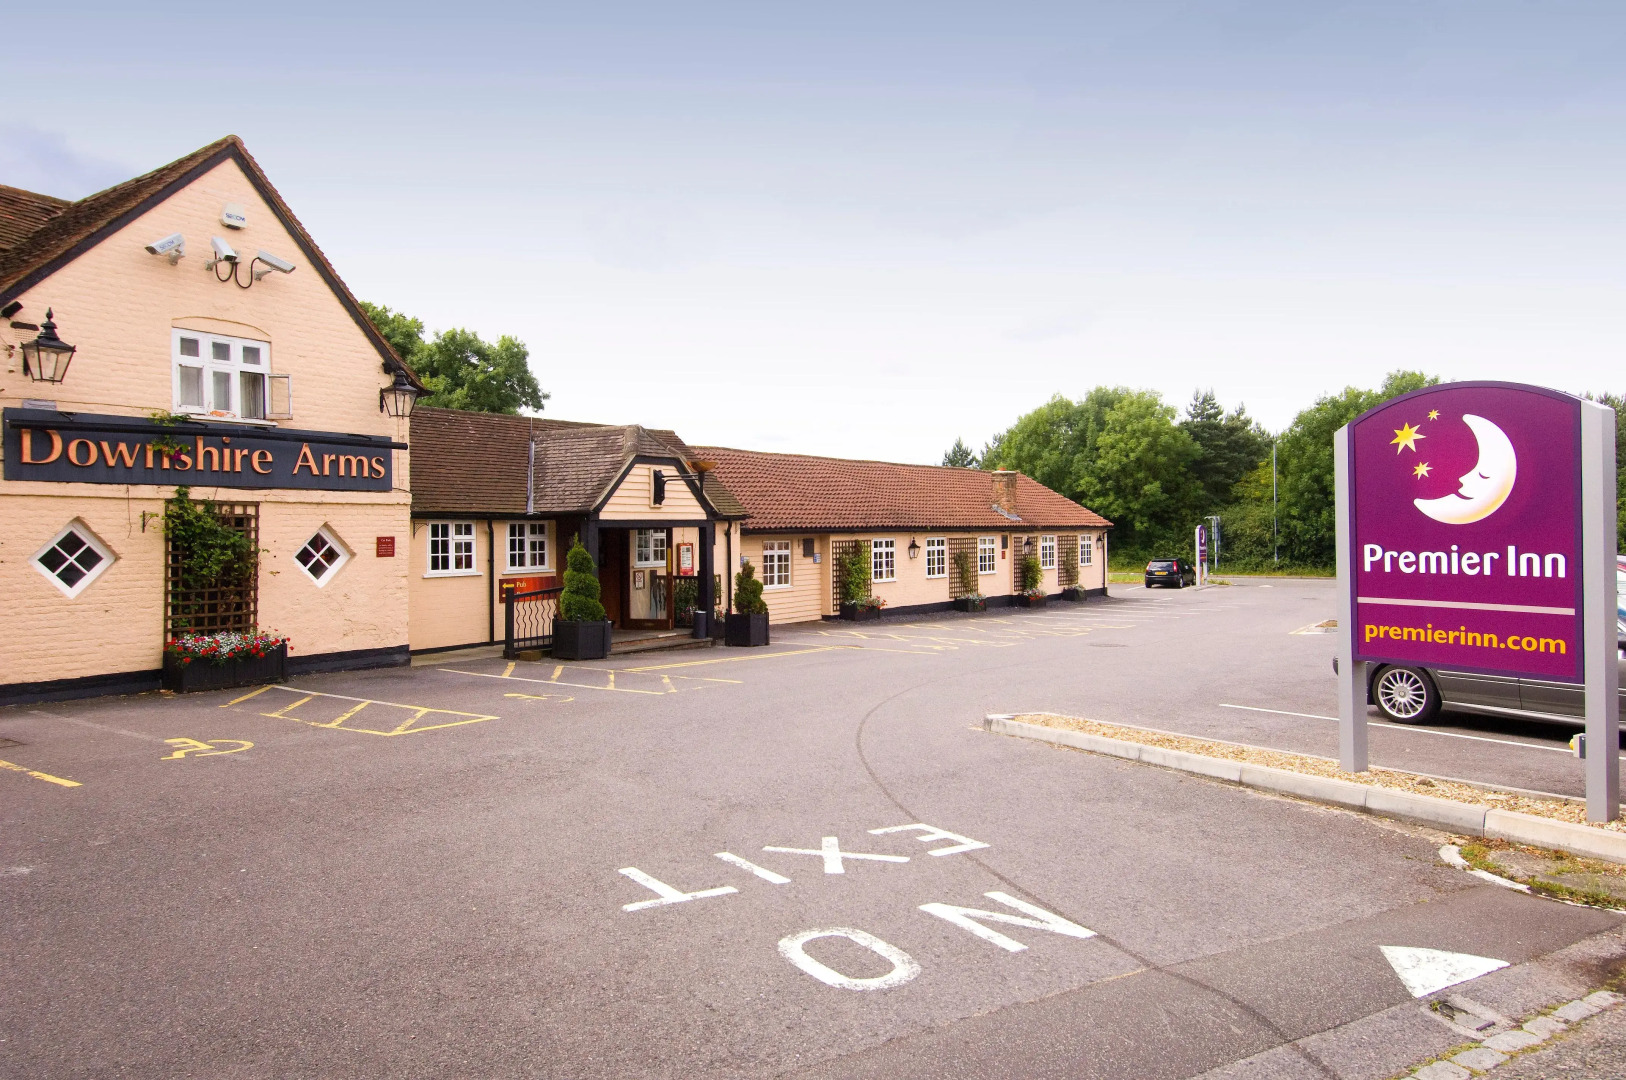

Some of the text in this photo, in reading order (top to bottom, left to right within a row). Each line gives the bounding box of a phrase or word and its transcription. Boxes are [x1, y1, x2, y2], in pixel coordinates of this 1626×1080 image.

[20, 428, 386, 480] Downshire Arms
[1363, 543, 1566, 578] Premier Inn
[1364, 622, 1566, 655] premierinn.com
[618, 823, 991, 912] EXIT
[777, 891, 1098, 991] NO
